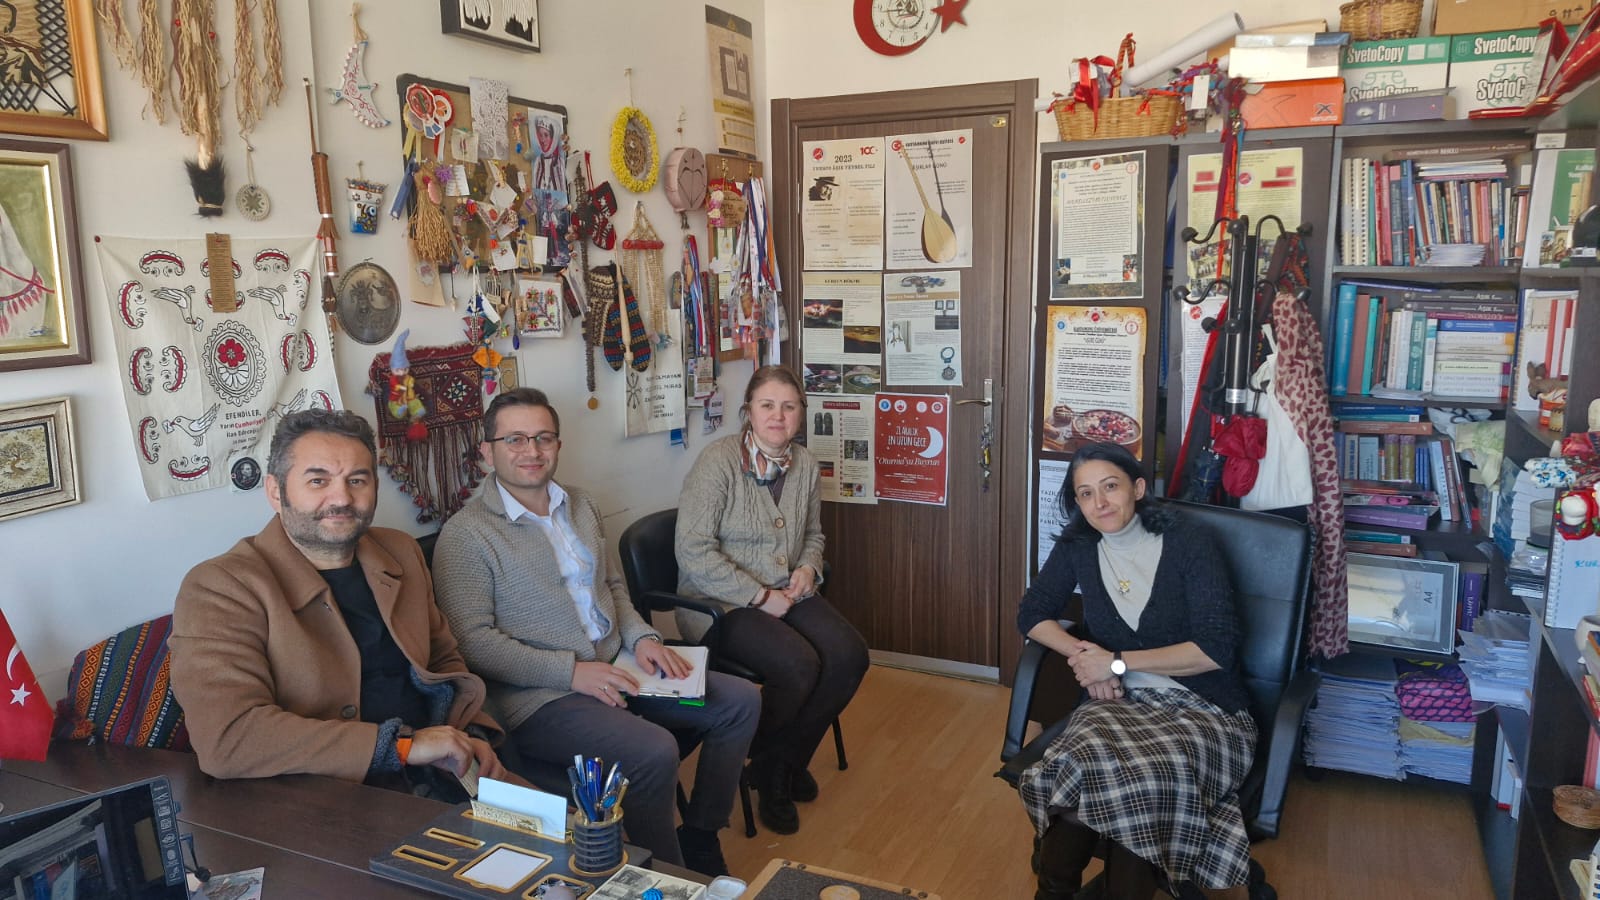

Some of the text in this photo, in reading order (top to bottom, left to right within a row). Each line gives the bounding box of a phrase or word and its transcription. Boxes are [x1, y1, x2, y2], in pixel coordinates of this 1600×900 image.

[1474, 34, 1538, 55] SvetoCopy
[1347, 45, 1405, 64] SvetoCopy
[834, 154, 853, 163] 2023
